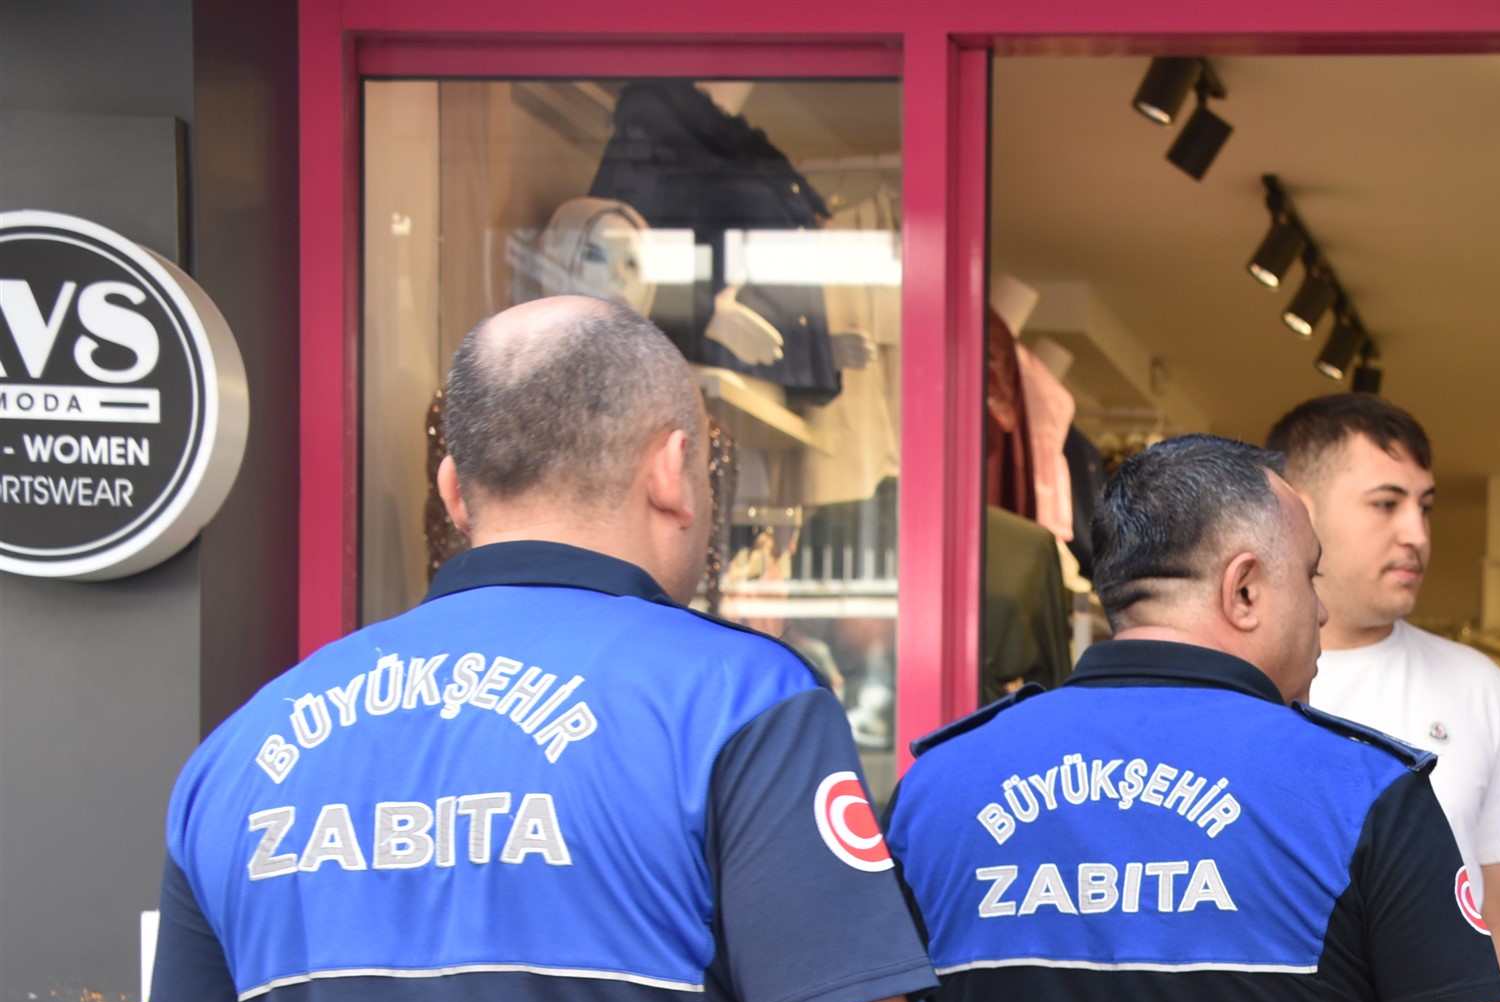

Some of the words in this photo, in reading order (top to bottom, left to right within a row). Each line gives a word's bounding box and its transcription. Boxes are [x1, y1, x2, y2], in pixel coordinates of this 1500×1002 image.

[0, 279, 159, 383] VS
[0, 474, 134, 507] RTSWEAR
[23, 433, 149, 466] WOMEN
[255, 652, 598, 784] BÜYÜKŞEHİR
[248, 792, 573, 881] ZABITA
[976, 753, 1241, 845] BÜYÜKŞEHİR
[976, 859, 1239, 917] ZABITA
